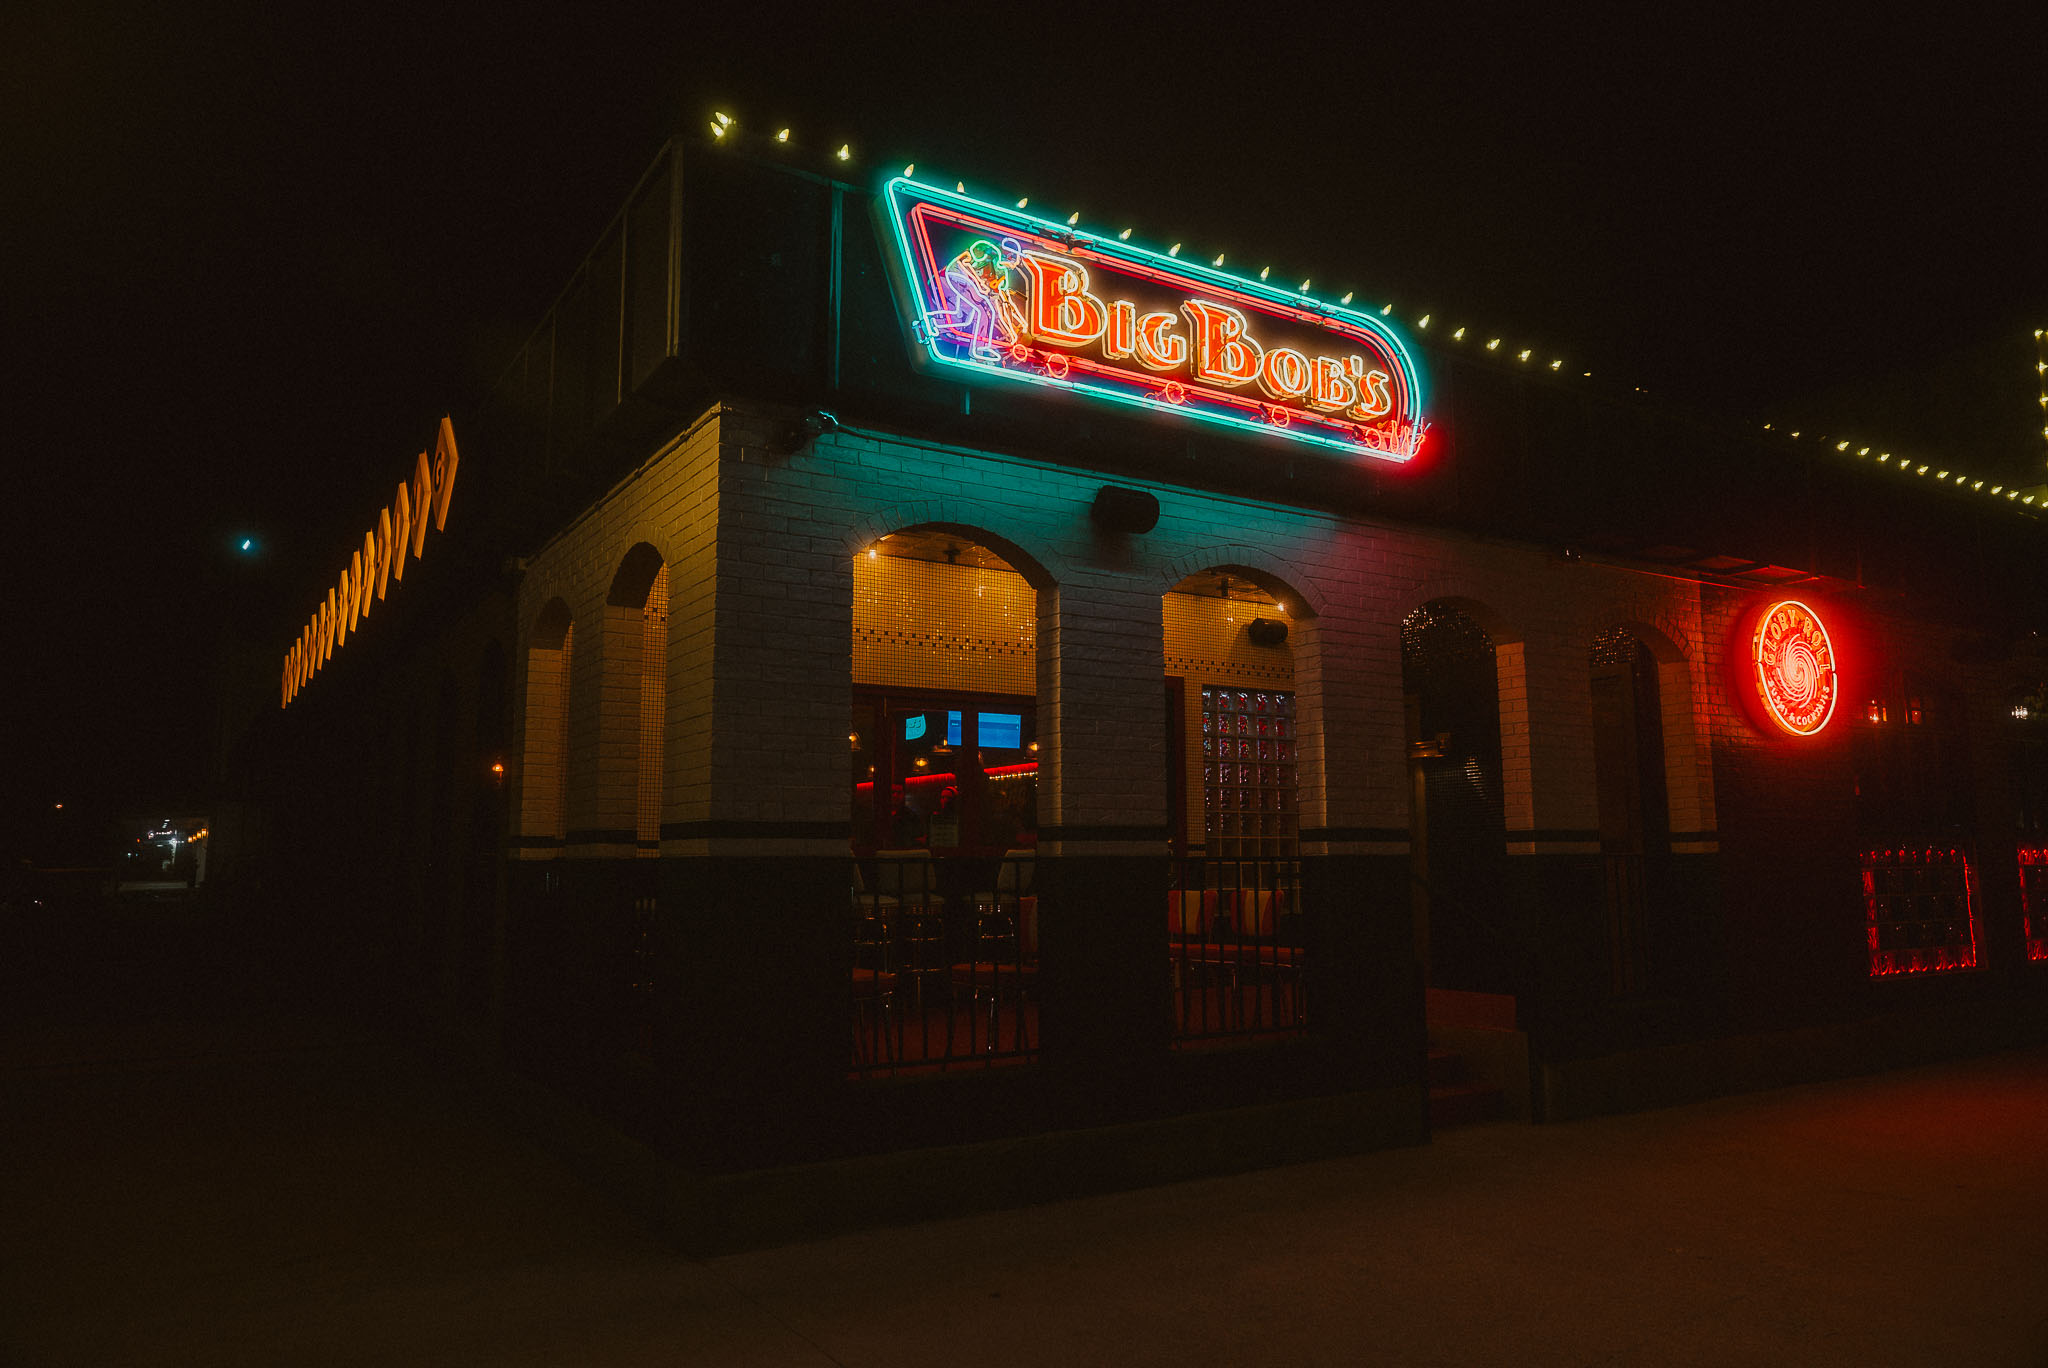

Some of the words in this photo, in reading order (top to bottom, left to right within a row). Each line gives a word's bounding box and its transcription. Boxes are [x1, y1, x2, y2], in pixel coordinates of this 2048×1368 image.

[1021, 249, 1187, 371] BIG
[1764, 609, 1796, 665] GLORY
[1803, 616, 1830, 675] ROLL
